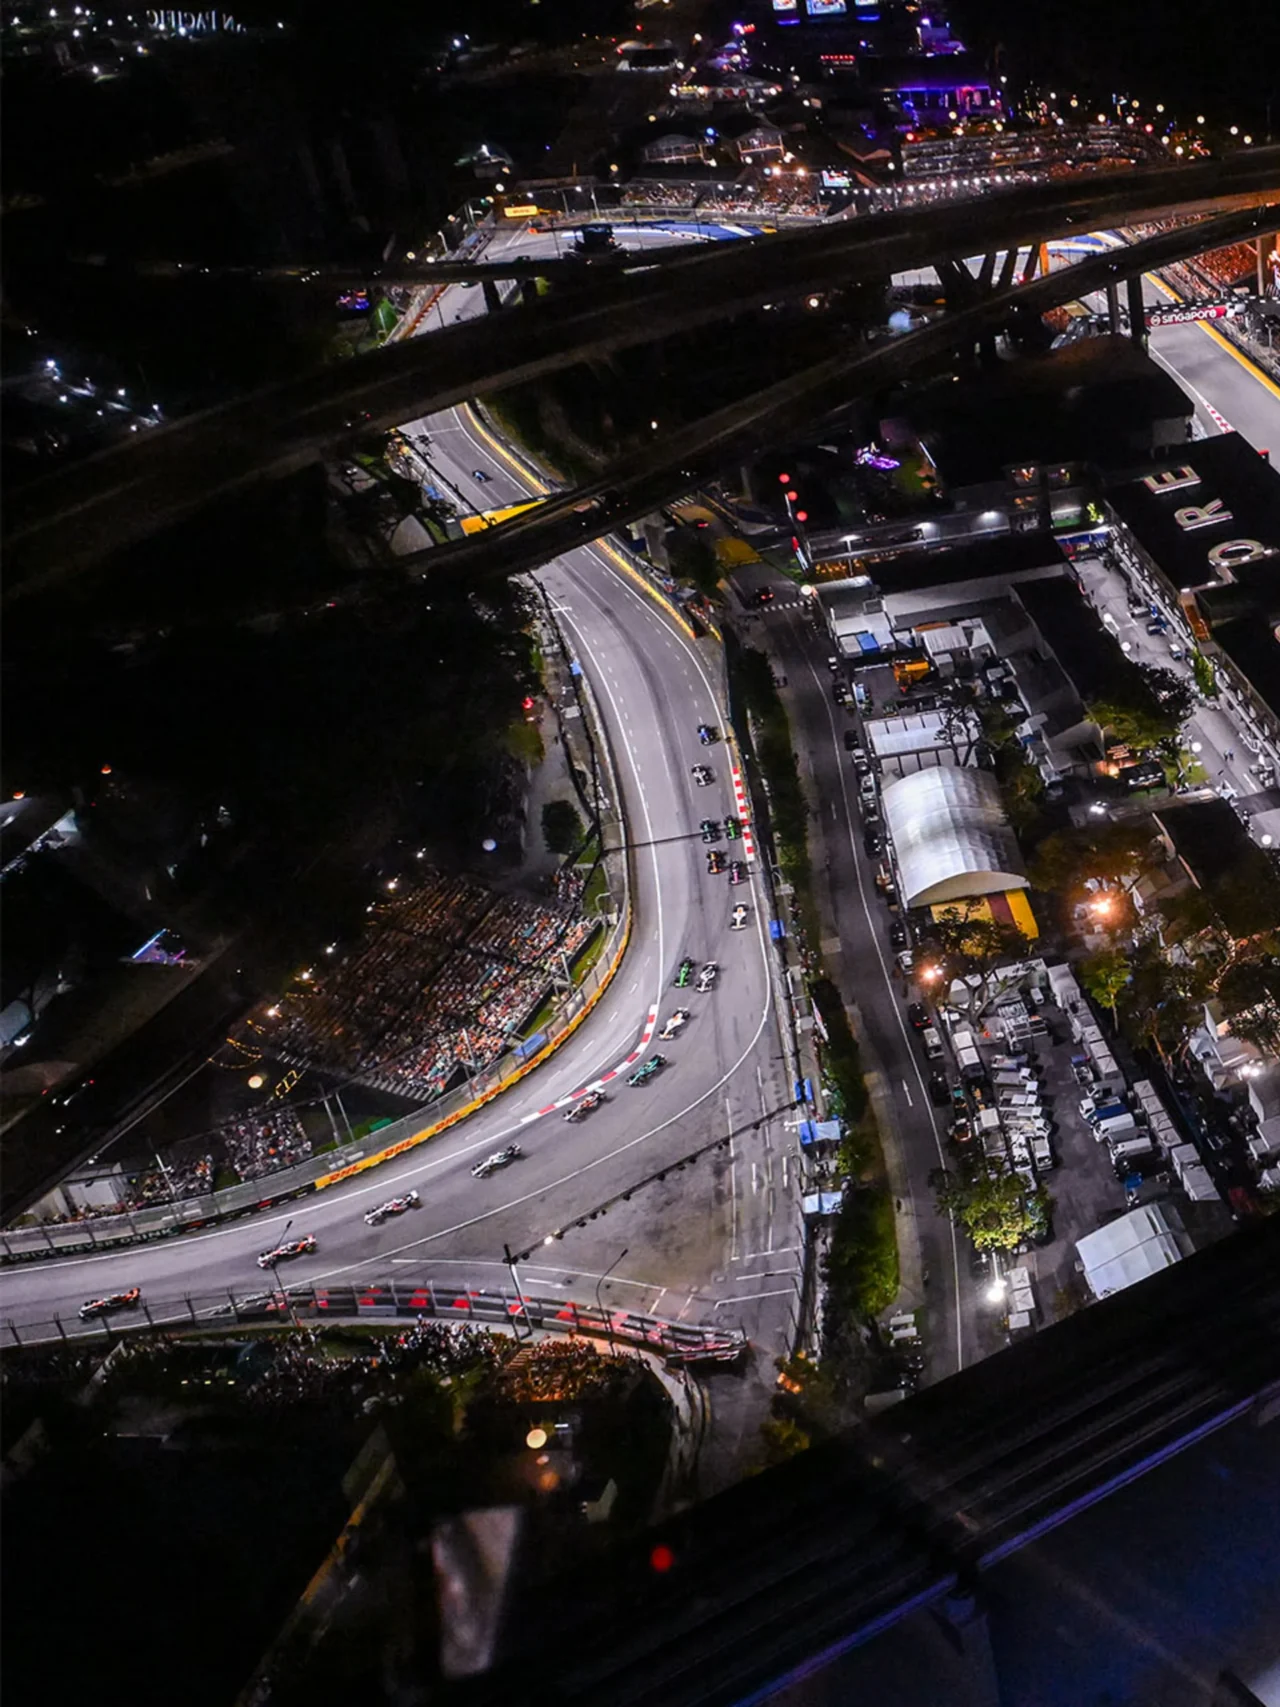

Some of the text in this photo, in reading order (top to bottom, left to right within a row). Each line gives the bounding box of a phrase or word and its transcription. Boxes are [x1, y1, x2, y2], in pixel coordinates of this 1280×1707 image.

[435, 1112, 461, 1131] DHL
[383, 1138, 413, 1157] DHL
[329, 1165, 361, 1181] DHL
[8, 1249, 57, 1261] DRIVE
[62, 1239, 114, 1253] NEVER
[119, 1228, 173, 1244] DRINK
